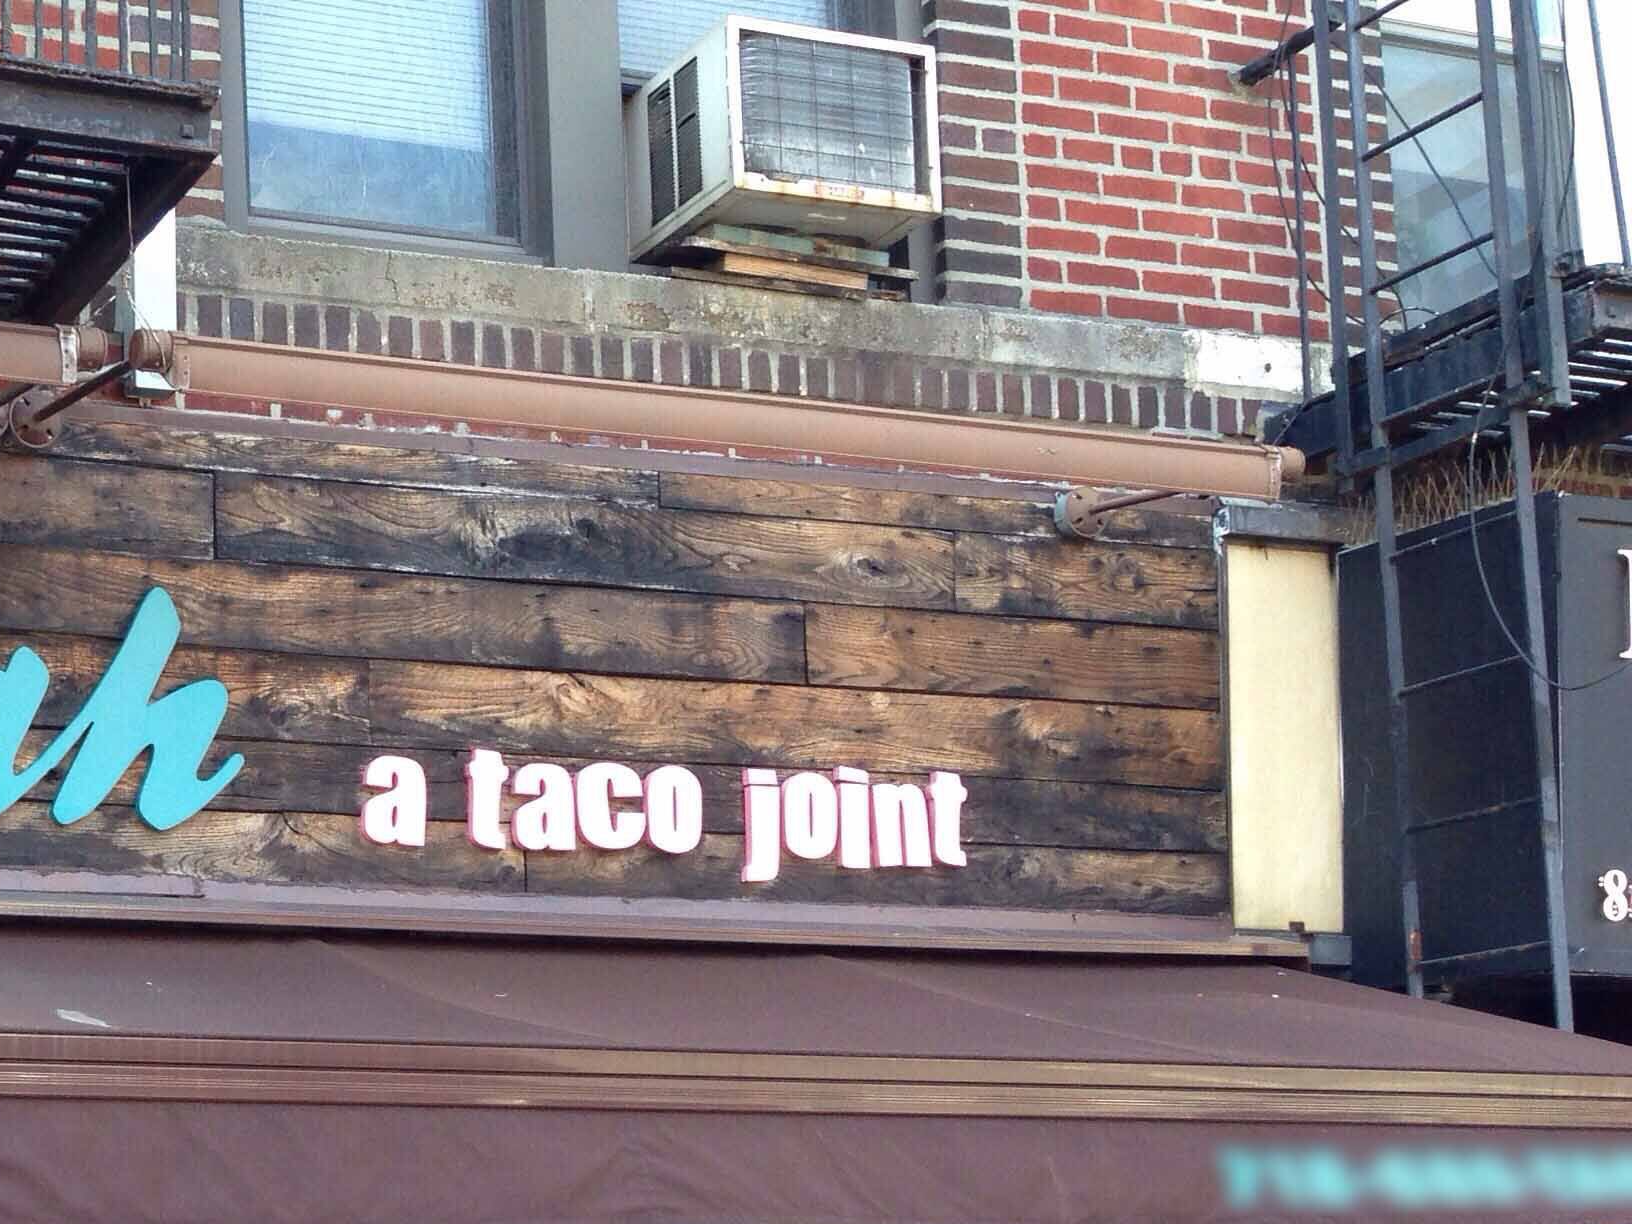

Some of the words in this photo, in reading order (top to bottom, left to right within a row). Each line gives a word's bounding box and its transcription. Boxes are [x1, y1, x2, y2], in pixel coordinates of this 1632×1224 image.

[360, 754, 427, 847] a
[466, 748, 703, 853] taco
[742, 765, 968, 882] joint
